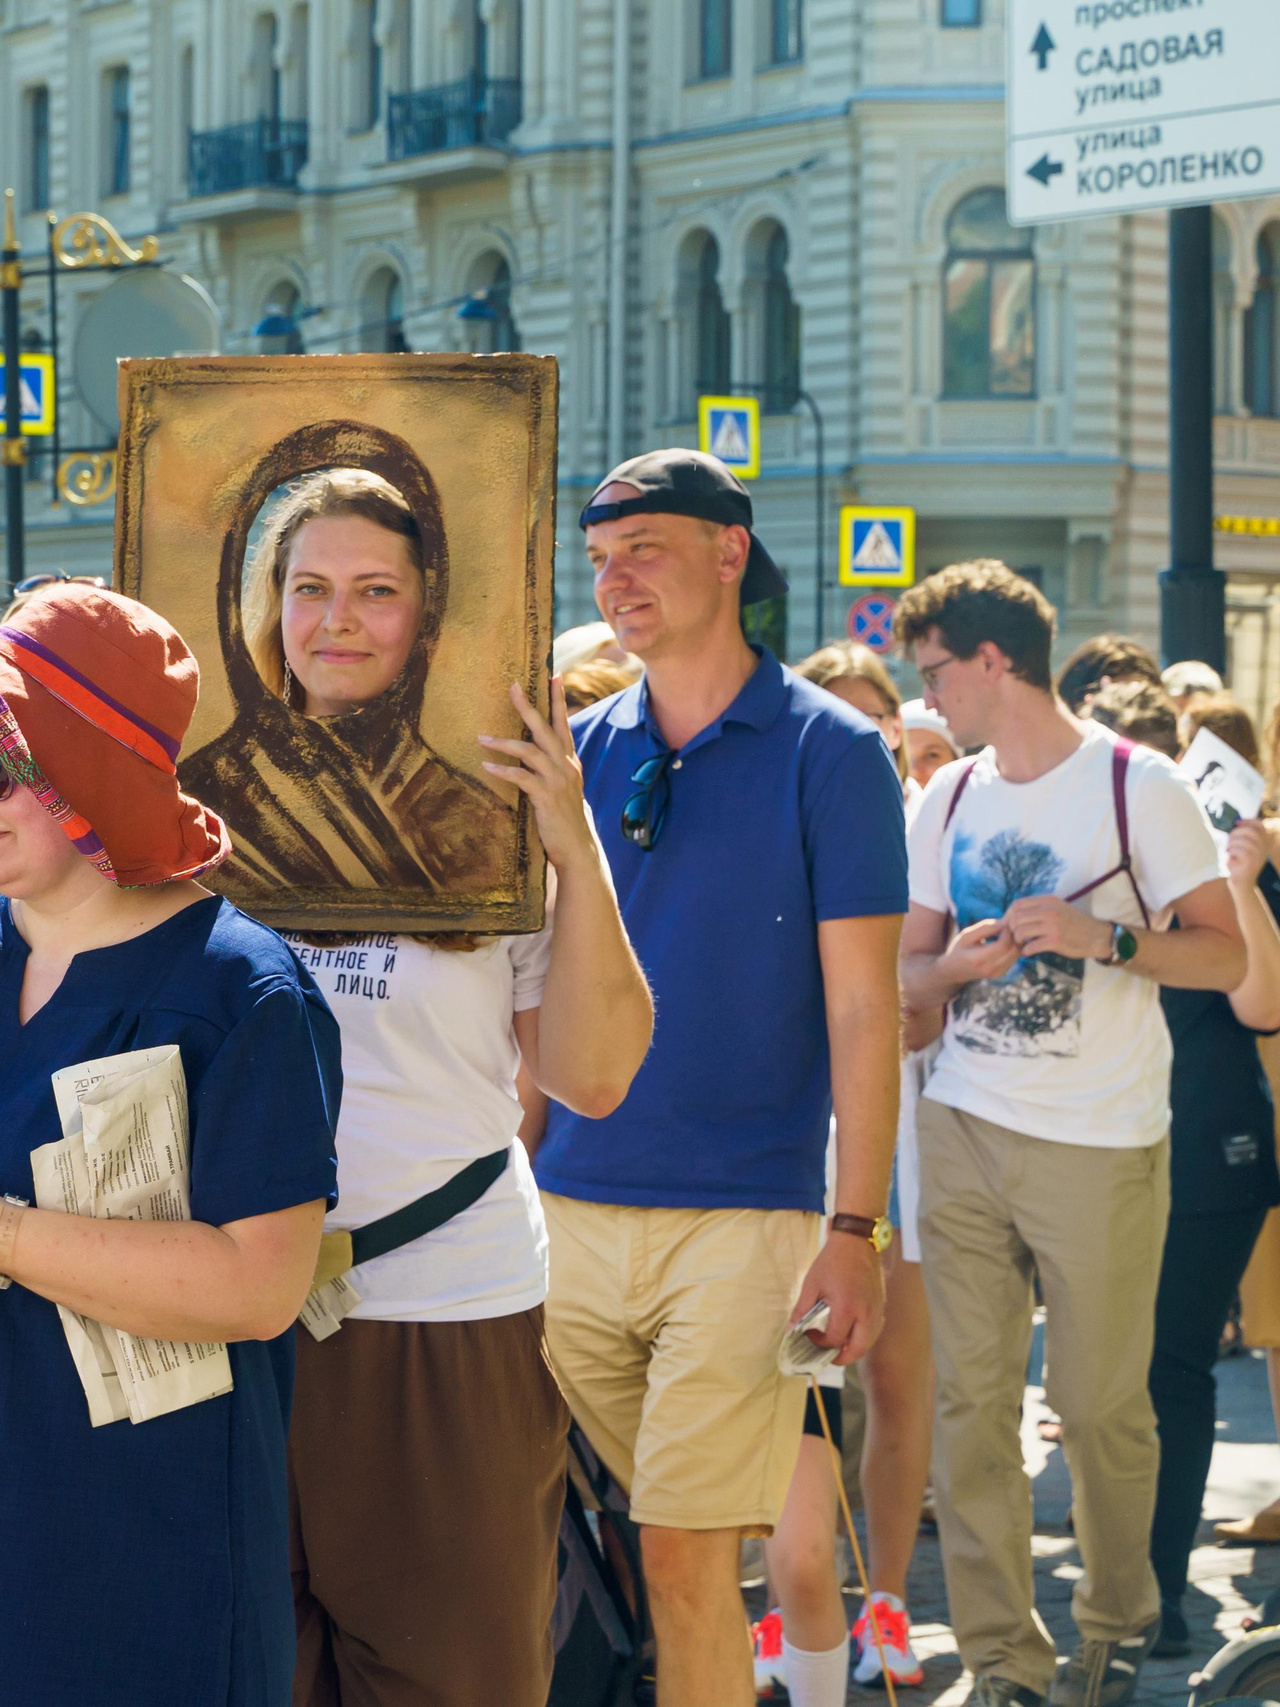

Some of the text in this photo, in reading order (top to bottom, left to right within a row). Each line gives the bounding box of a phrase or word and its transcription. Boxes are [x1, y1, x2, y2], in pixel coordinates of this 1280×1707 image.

[1075, 0, 1203, 29] проспе
[1076, 28, 1224, 76] САДОВАЯ
[1075, 76, 1162, 115] улица
[1075, 125, 1162, 163] улица
[1077, 146, 1263, 195] КОРОЛЕНКО
[383, 953, 396, 973] И
[334, 973, 391, 1000] ЛИЦО.
